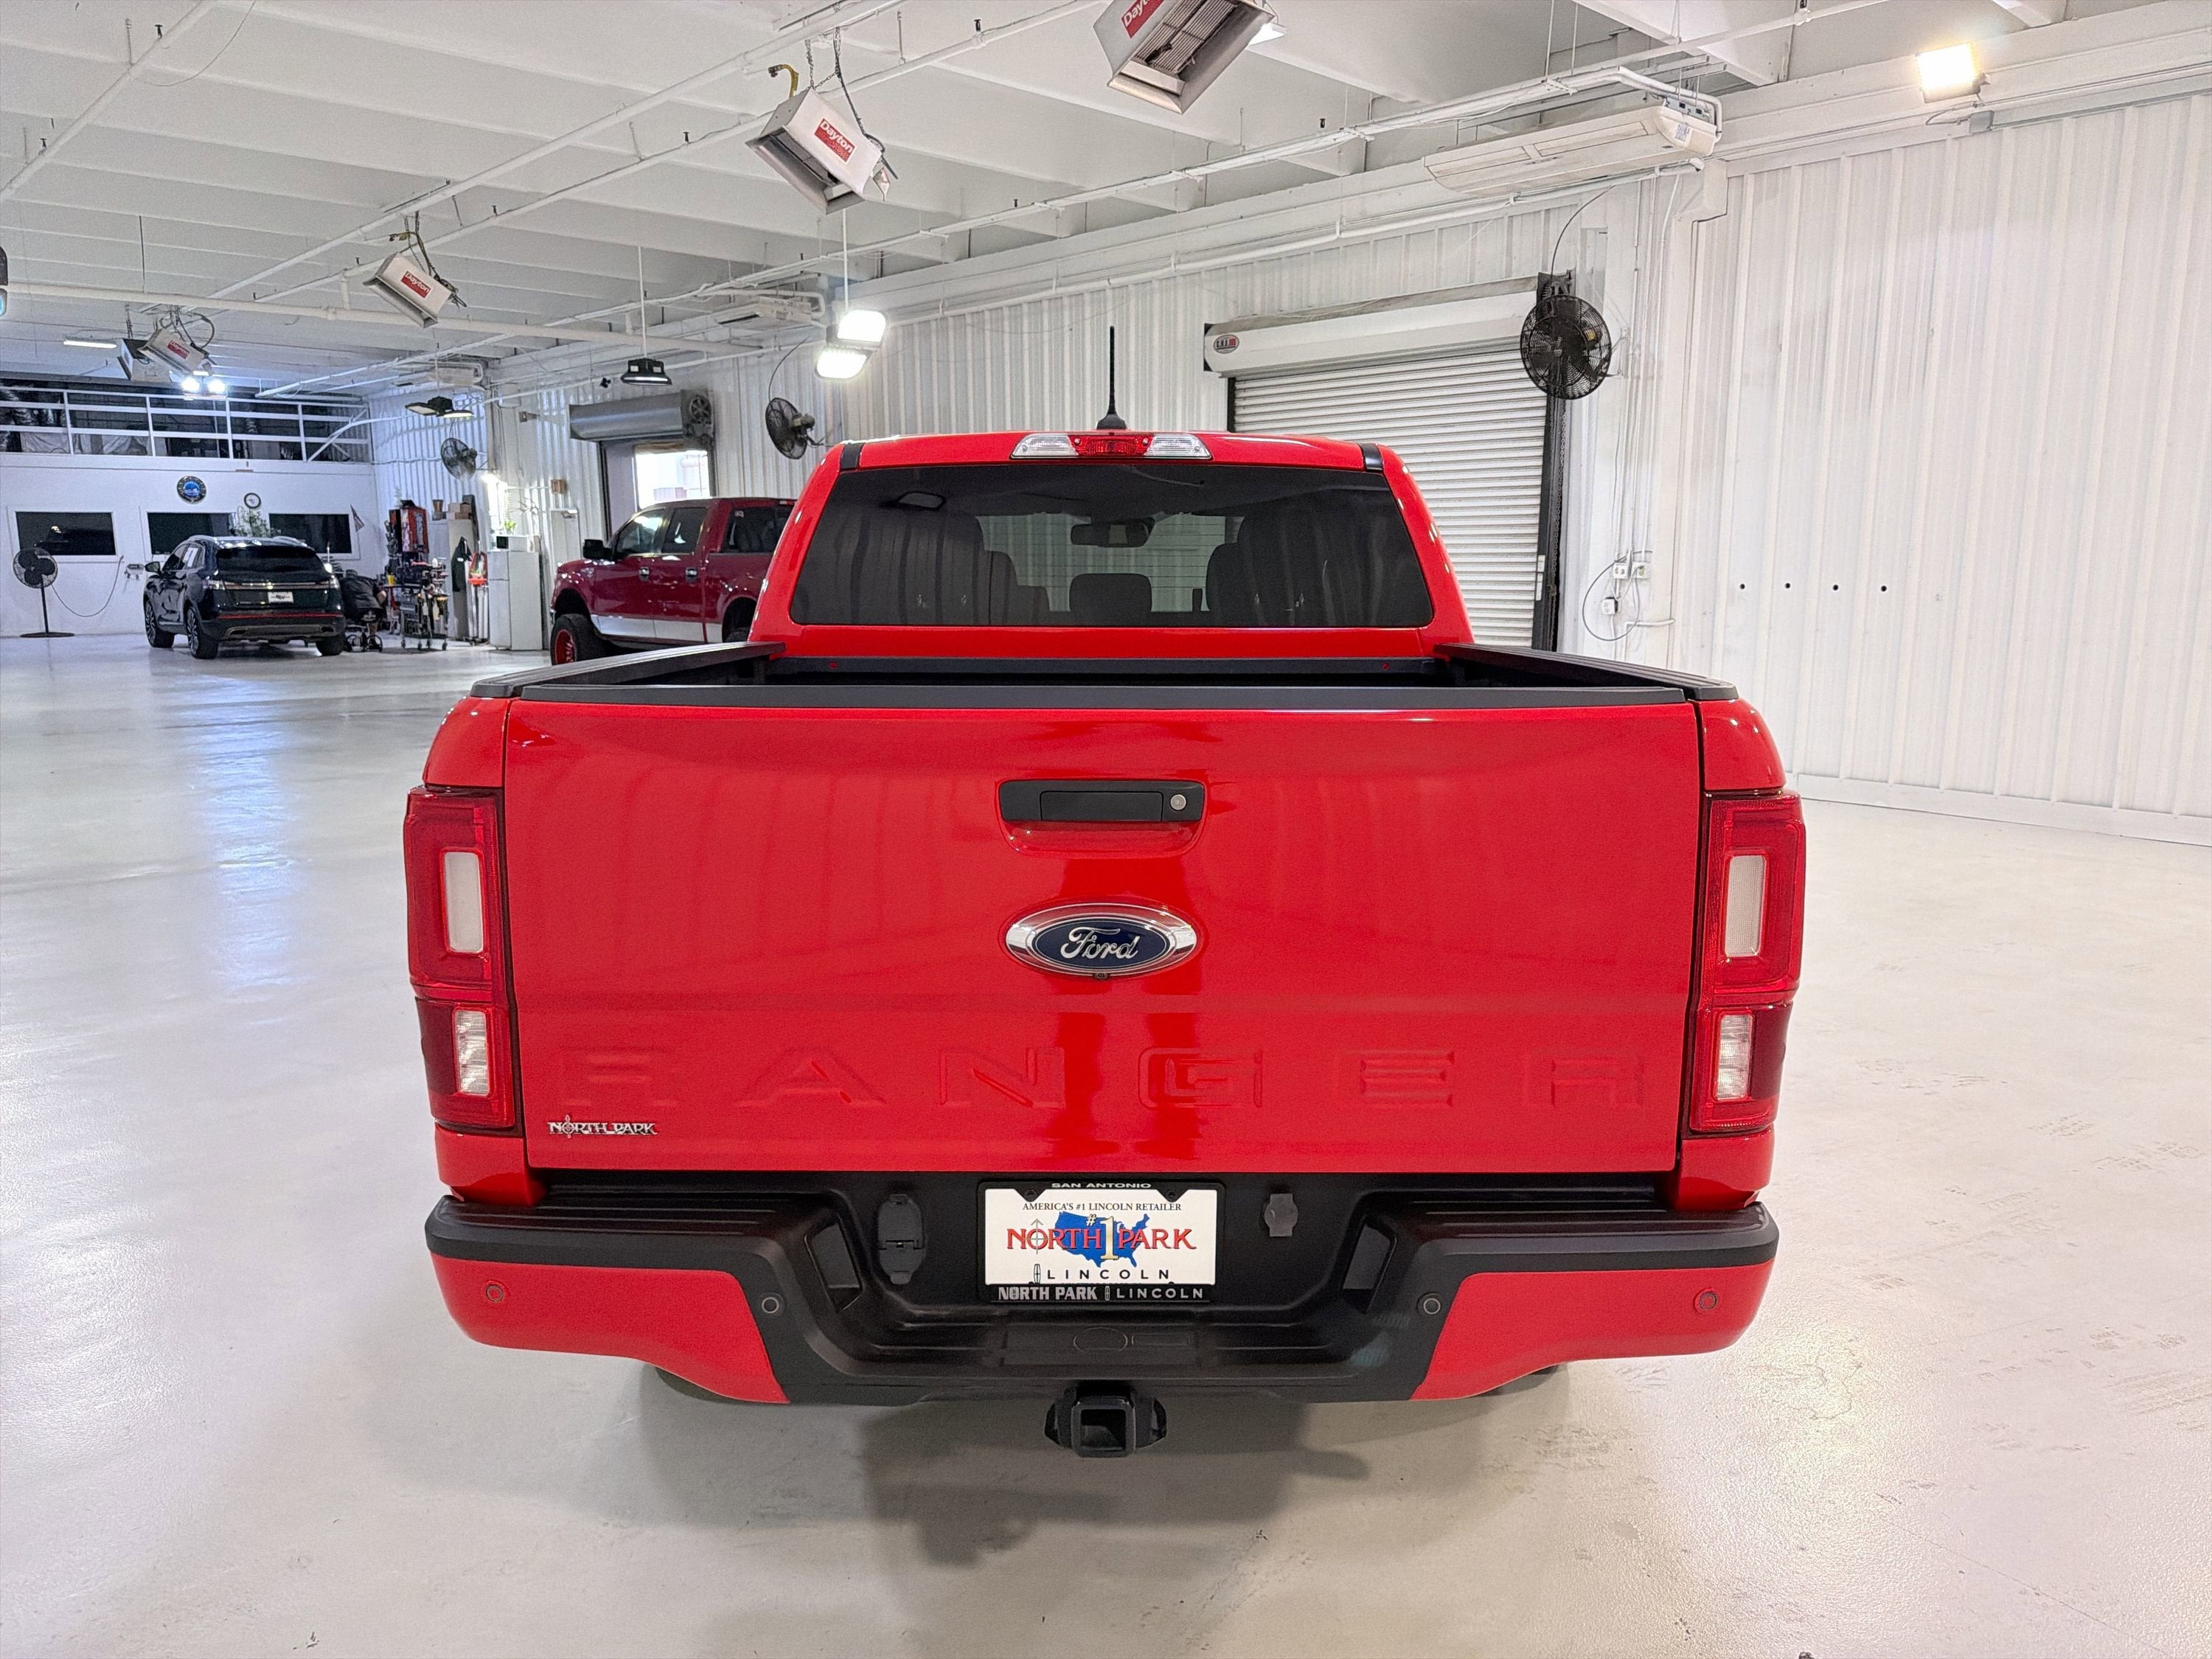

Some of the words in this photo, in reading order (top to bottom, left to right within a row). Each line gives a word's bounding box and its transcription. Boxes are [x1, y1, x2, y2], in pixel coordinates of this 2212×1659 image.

[820, 121, 853, 153] Dayton
[405, 271, 430, 293] Dayton
[1060, 926, 1141, 959] Ford
[560, 1045, 1644, 1107] RANGER
[547, 1121, 608, 1135] NORTH
[611, 1122, 658, 1135] PARK
[1022, 1202, 1074, 1211] AMERICA'S
[1076, 1203, 1086, 1211] #1
[1088, 1203, 1133, 1211] LINCOLN
[1135, 1203, 1182, 1211] RETAILER
[1006, 1228, 1102, 1251] NORTH
[1118, 1228, 1197, 1251] PARK
[1047, 1269, 1169, 1280] LINCOLN
[998, 1286, 1050, 1301] NORTH
[1055, 1286, 1098, 1301] PARK
[1116, 1287, 1203, 1299] LINCOLN
